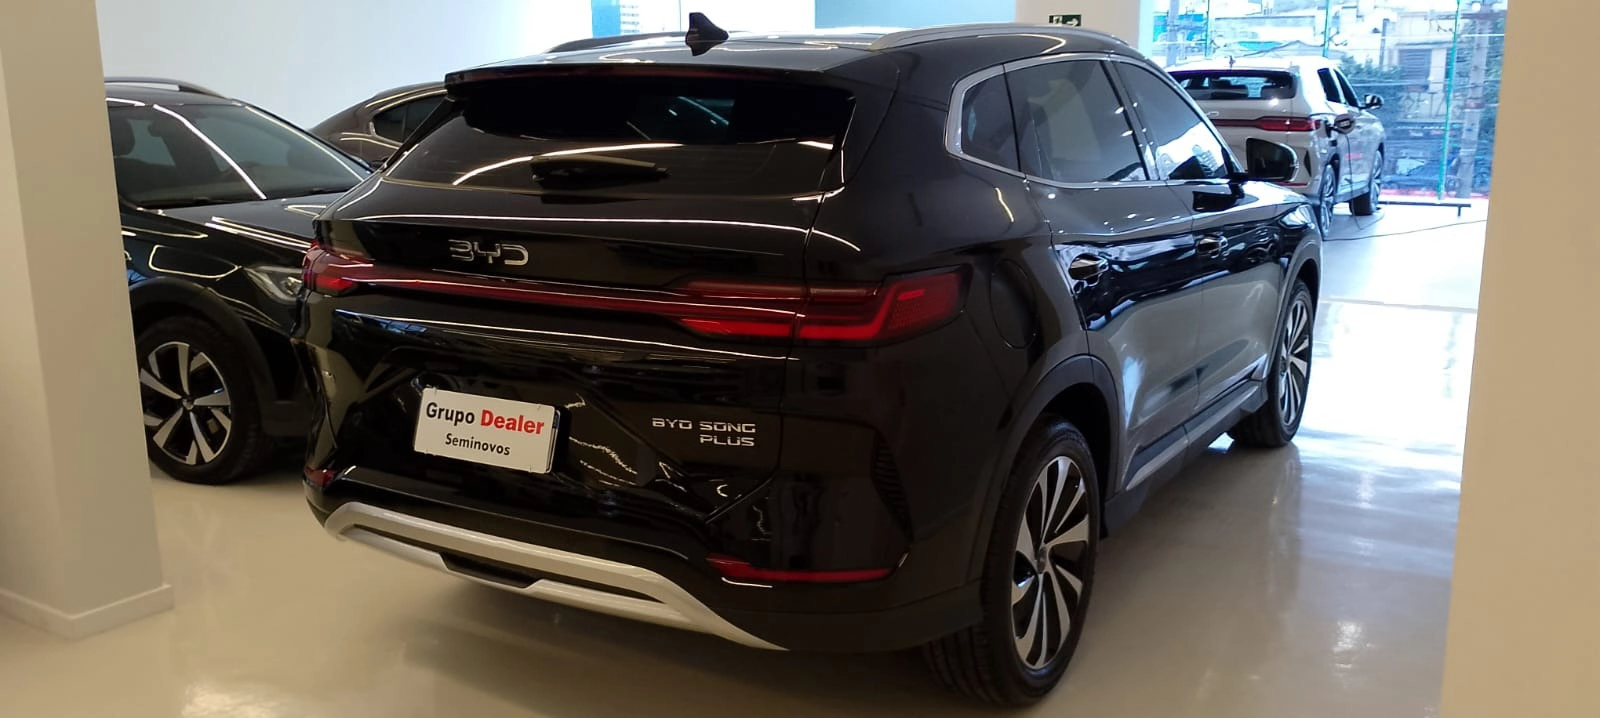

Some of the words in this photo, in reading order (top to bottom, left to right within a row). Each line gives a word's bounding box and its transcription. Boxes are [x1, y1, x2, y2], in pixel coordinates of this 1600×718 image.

[448, 239, 529, 266] BYD
[426, 401, 475, 427] Grupo
[480, 409, 545, 435] Dealer
[652, 417, 692, 430] BYD
[699, 421, 756, 433] SONG
[445, 432, 511, 456] Seminovos
[700, 434, 755, 447] PLUS
